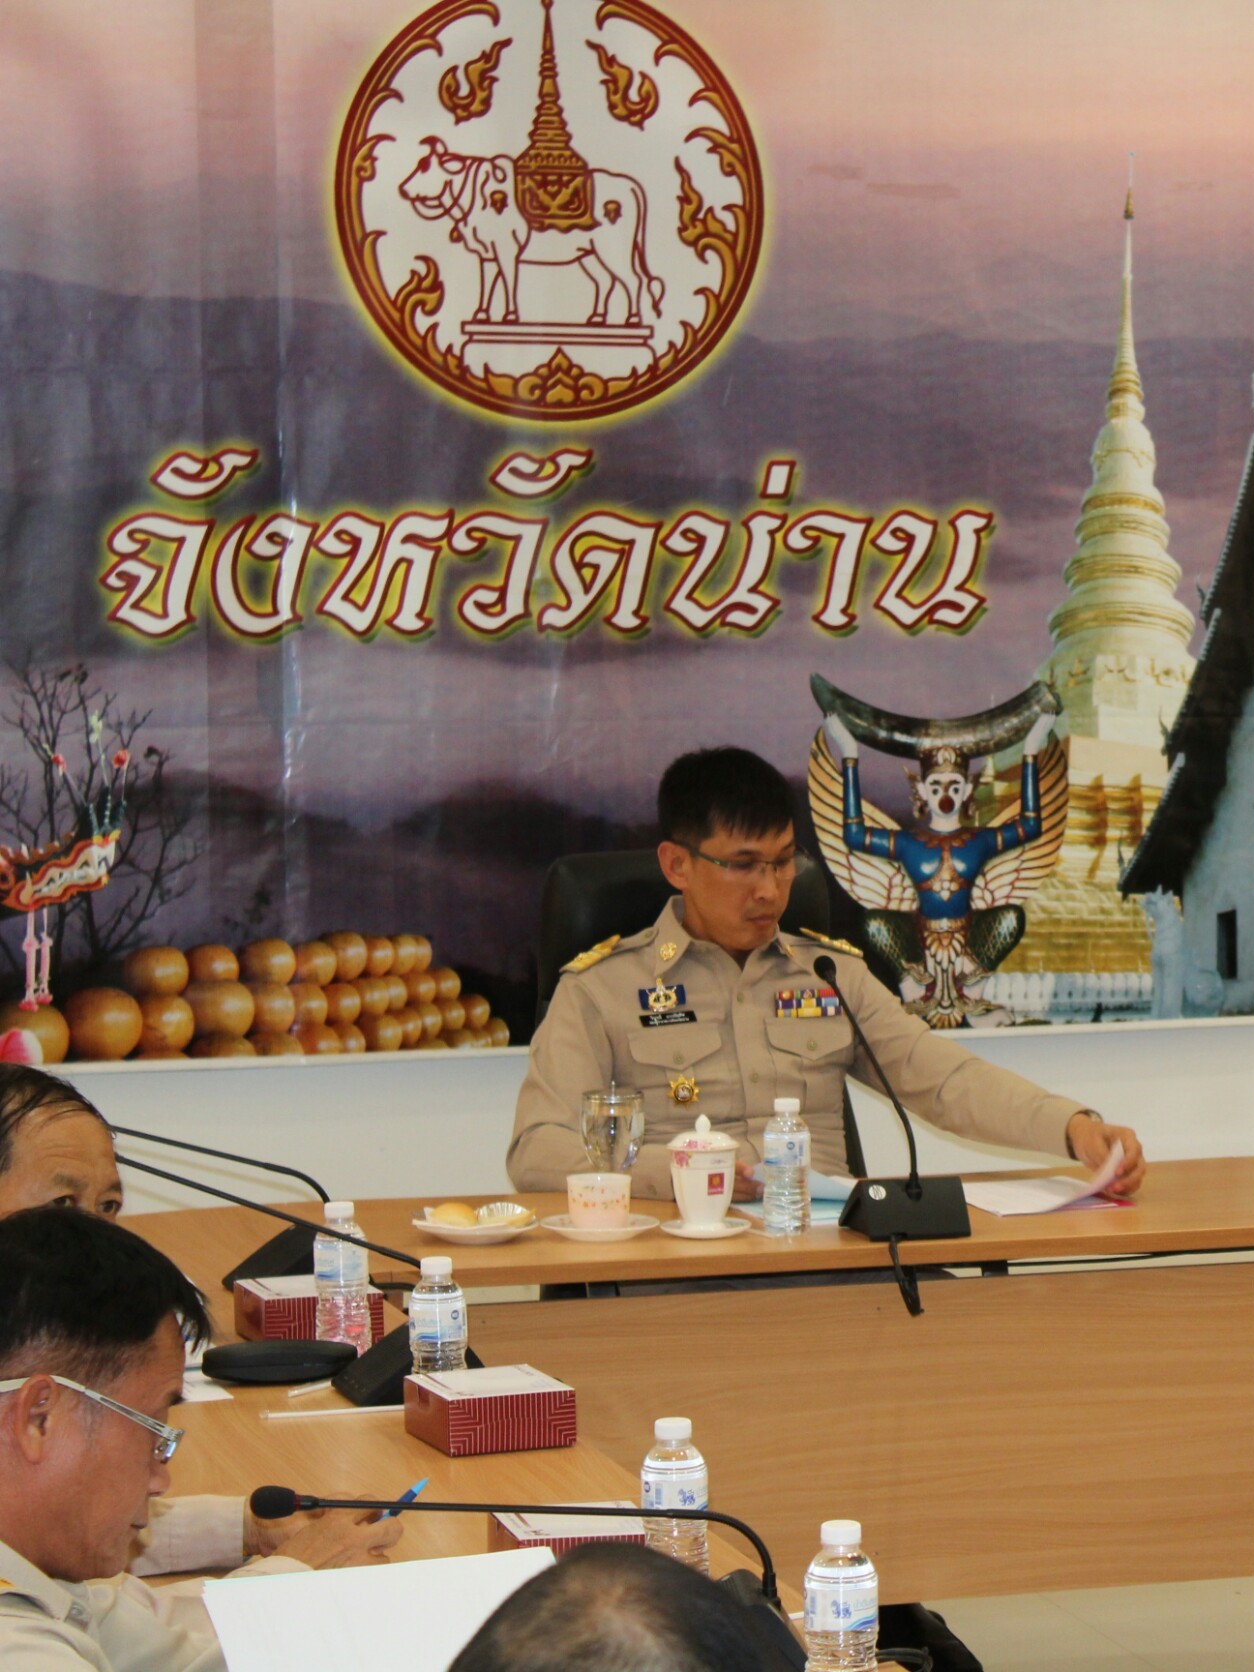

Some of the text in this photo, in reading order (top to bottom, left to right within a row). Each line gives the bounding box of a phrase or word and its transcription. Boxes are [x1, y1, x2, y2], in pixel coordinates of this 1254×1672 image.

[100, 448, 994, 635] จังหวัดน่าน
